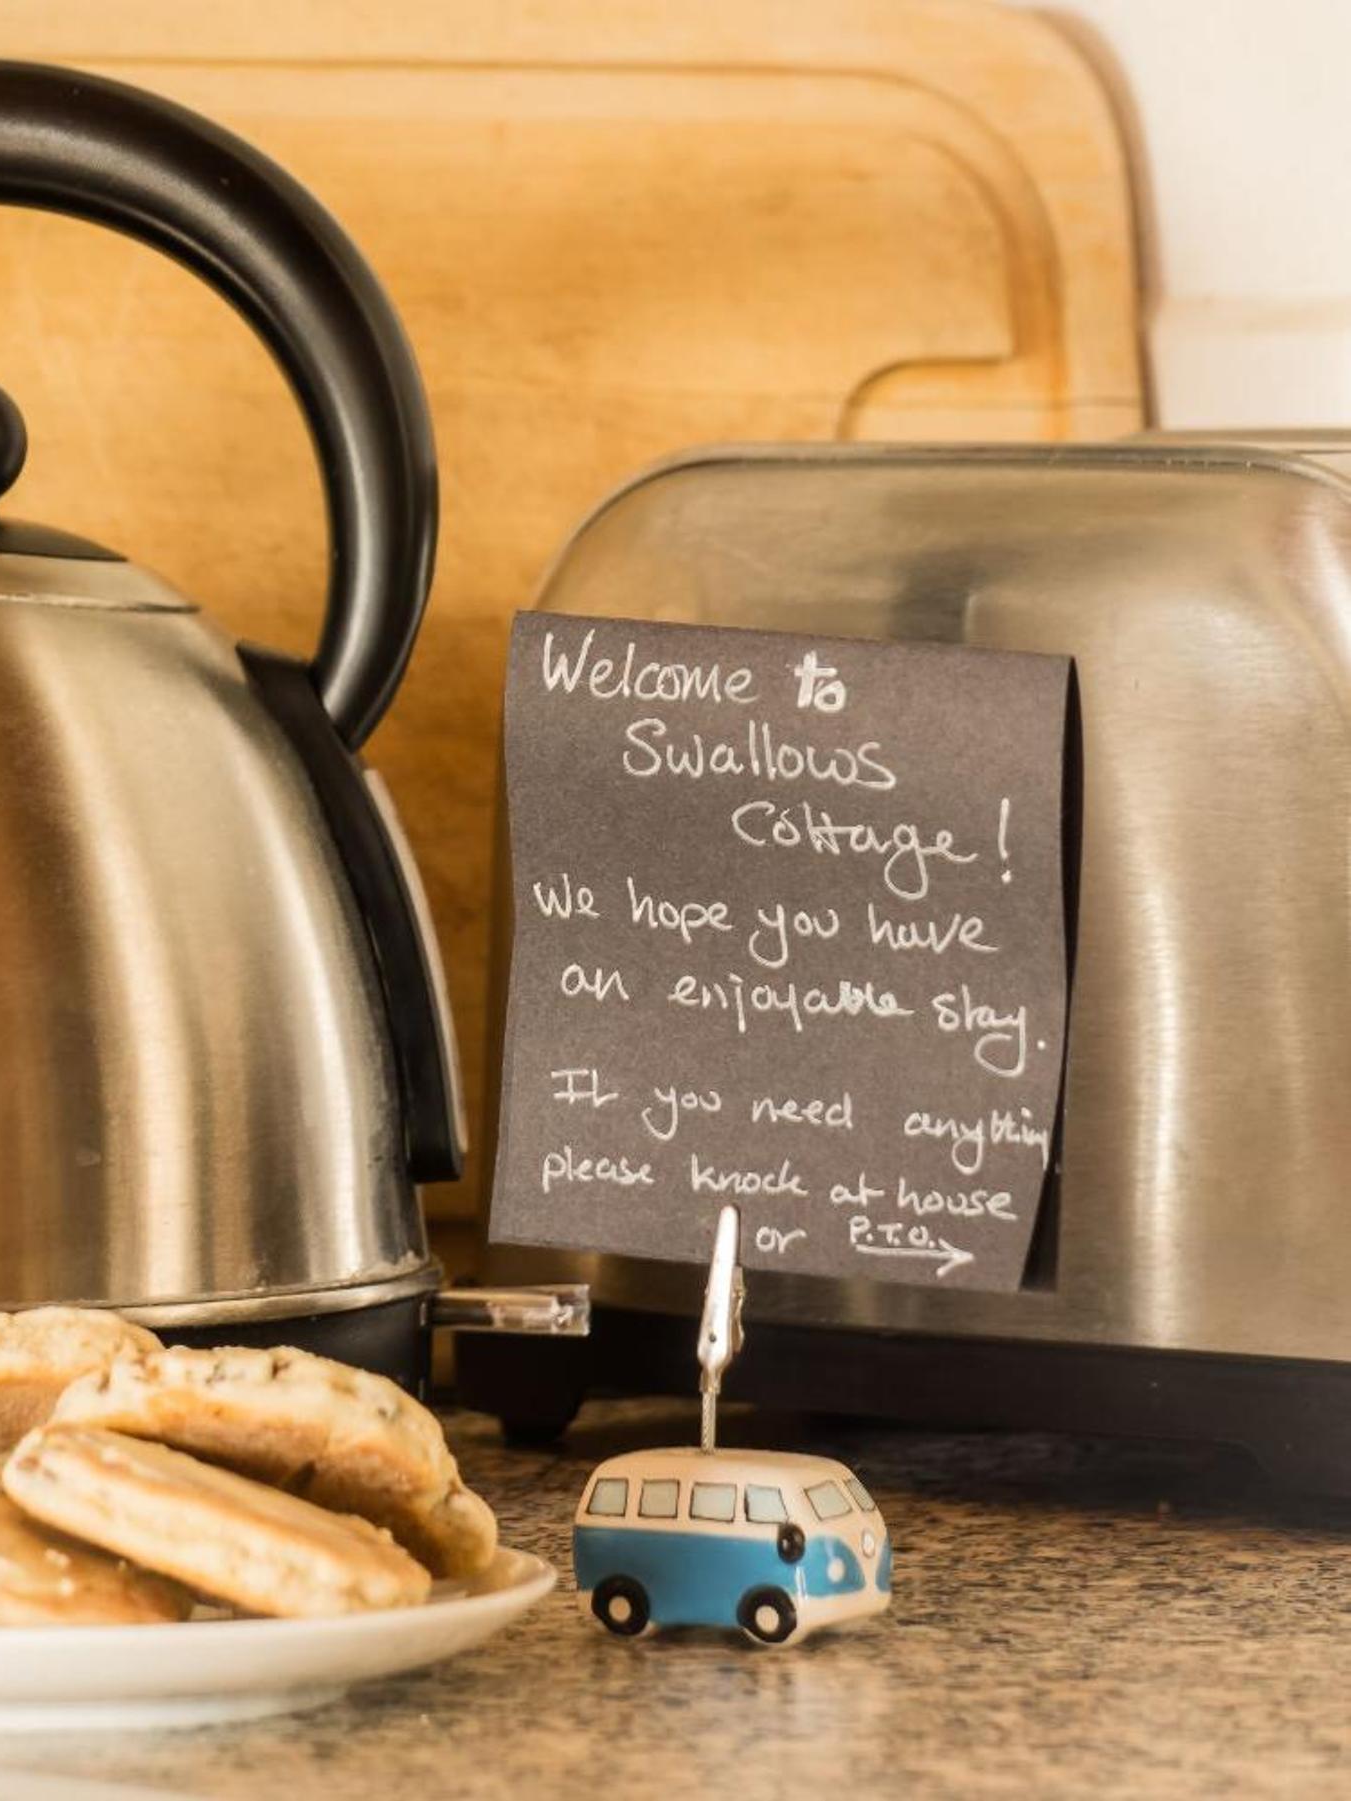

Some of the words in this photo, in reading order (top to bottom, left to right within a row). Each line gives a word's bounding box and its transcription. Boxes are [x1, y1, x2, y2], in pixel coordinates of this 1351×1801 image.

[541, 629, 757, 702] Welcome
[793, 650, 847, 712] to
[623, 717, 896, 790] Swallows
[533, 873, 600, 919] We
[626, 876, 733, 943] hope
[749, 904, 840, 967] you
[868, 903, 998, 952] have
[561, 964, 630, 1001] an
[669, 973, 914, 1032] enjoyable
[931, 985, 1048, 1076] stay.
[641, 1085, 721, 1140] you
[751, 1093, 853, 1130] need
[542, 1145, 655, 1194] please
[691, 1153, 808, 1200] knock
[830, 1173, 884, 1205] at
[897, 1176, 1018, 1221] house
[756, 1228, 806, 1254] or
